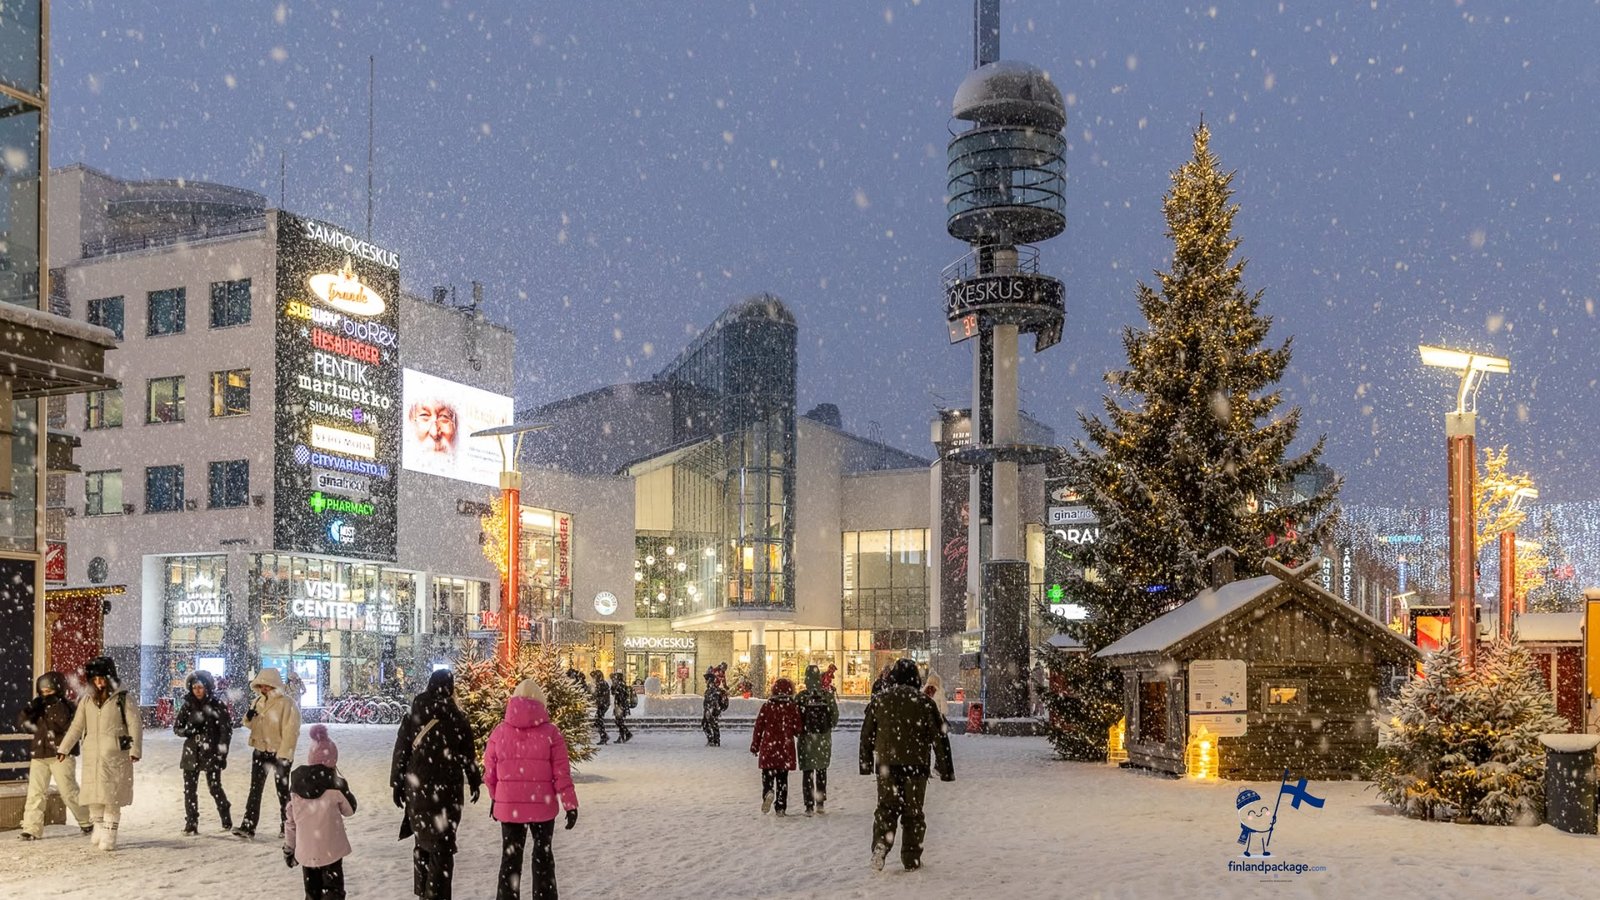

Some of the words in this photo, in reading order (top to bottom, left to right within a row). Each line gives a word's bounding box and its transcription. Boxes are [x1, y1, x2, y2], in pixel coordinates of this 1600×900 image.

[307, 221, 399, 269] SAMPOKESKUS
[287, 301, 341, 326] SUBWAY
[311, 328, 380, 365] HESBURGER
[299, 374, 390, 410] marimekko
[311, 453, 387, 476] CITYVARASTO.fi
[326, 499, 375, 516] PHARMACY
[559, 517, 569, 587] HESBURGER
[304, 580, 347, 600] VISIT
[178, 600, 223, 615] ROYAL
[292, 599, 357, 619] CENTER
